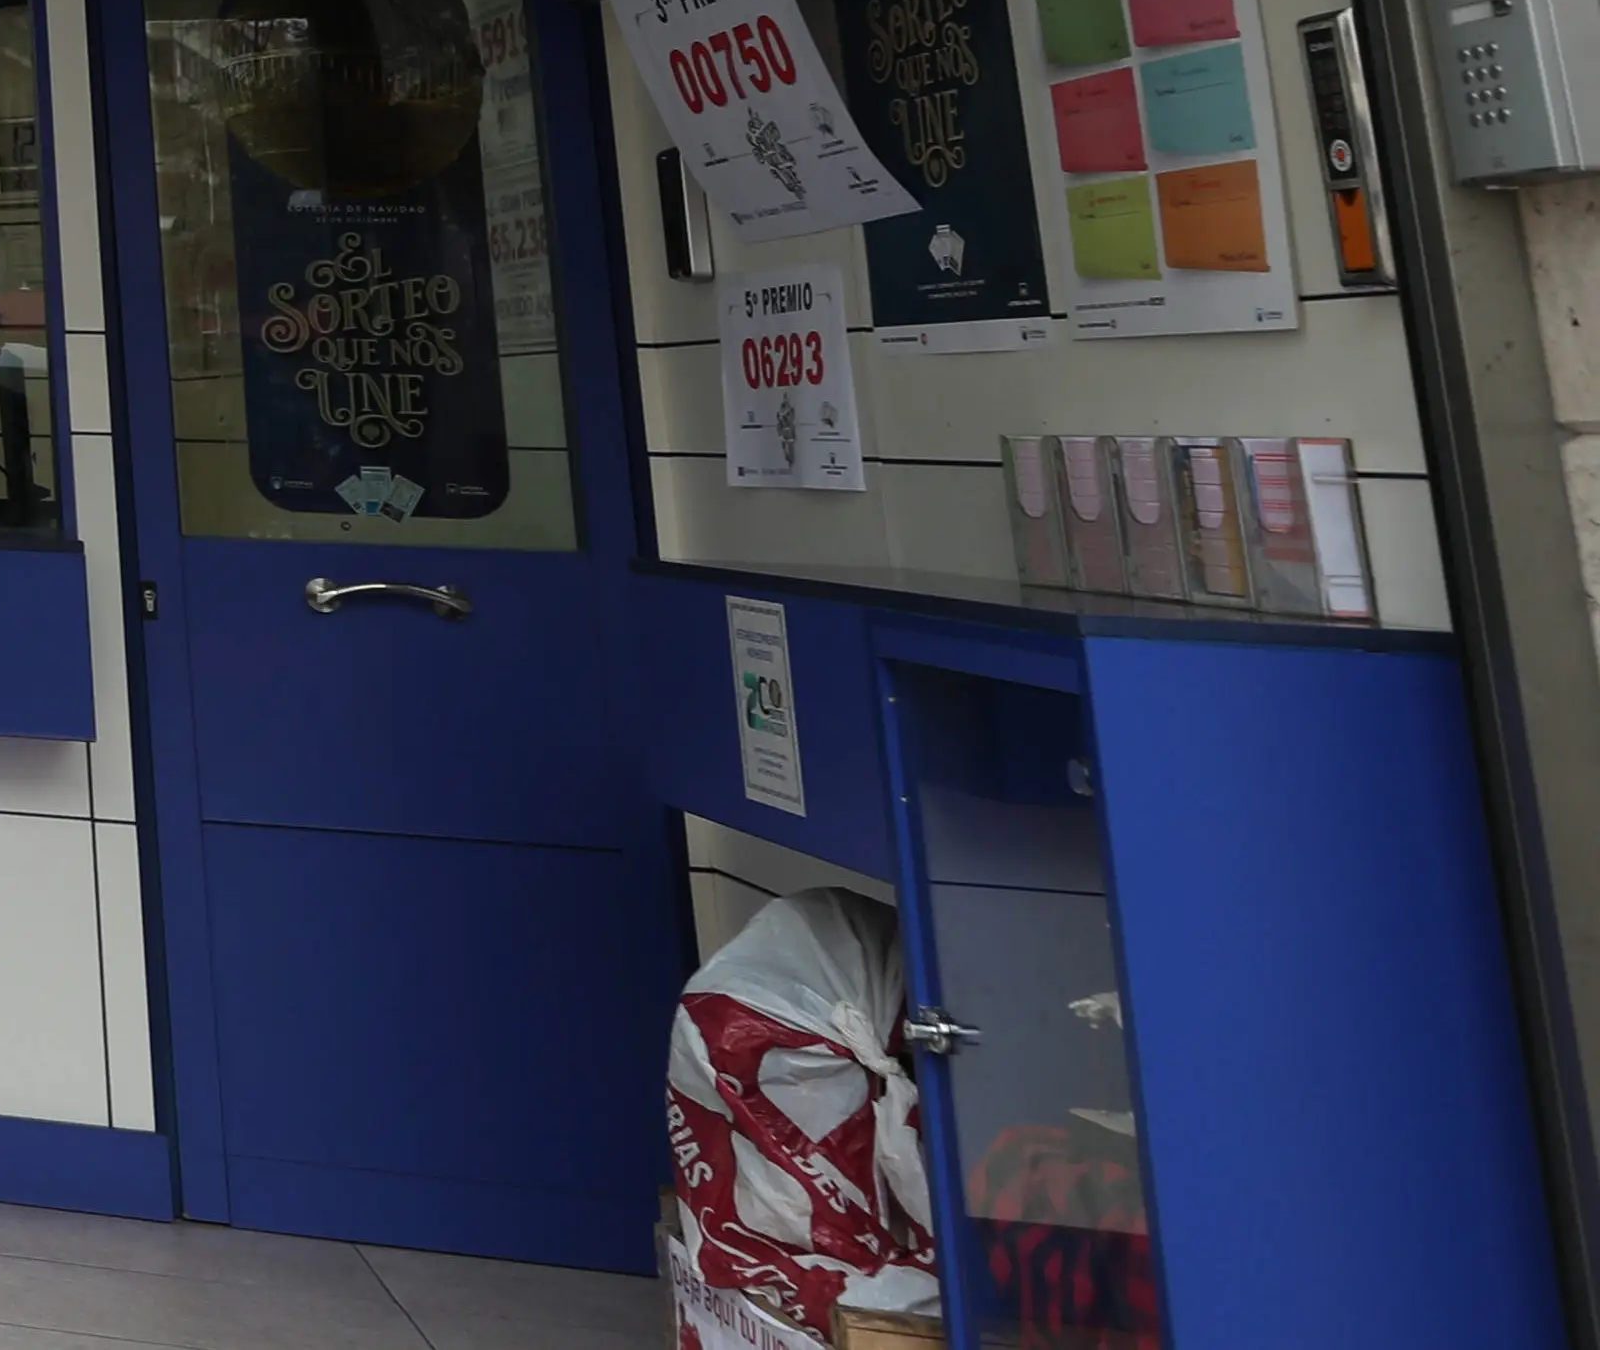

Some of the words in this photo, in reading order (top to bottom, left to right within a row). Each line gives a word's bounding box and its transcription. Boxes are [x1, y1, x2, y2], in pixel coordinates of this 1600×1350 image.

[669, 15, 797, 115] 00750
[261, 274, 461, 353] SORTEO
[761, 281, 814, 316] PREMIO
[312, 337, 380, 372] QUE
[391, 321, 464, 376] NOS
[742, 331, 825, 390] 06293
